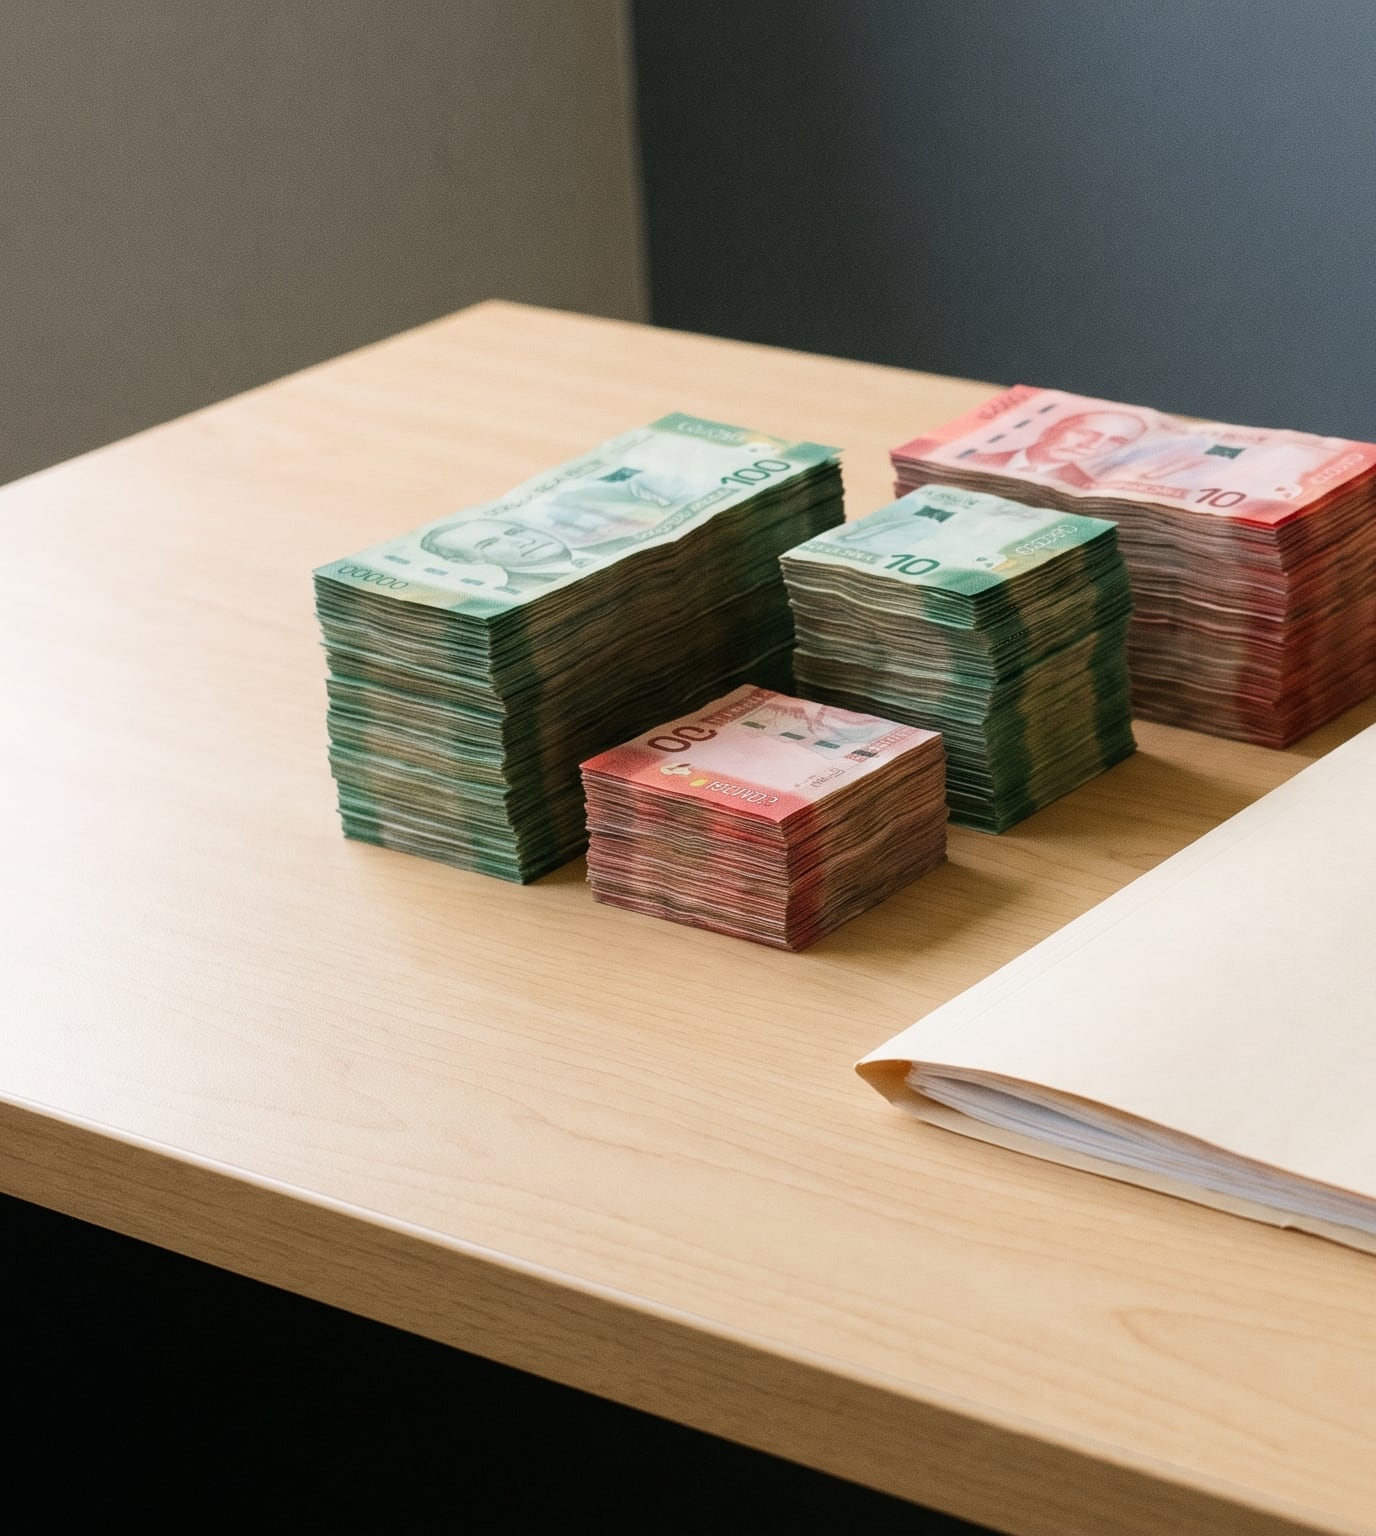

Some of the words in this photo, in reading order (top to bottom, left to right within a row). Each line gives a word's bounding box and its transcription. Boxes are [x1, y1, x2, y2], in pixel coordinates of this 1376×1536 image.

[720, 458, 791, 486] 100
[1195, 488, 1247, 509] 10
[884, 553, 940, 576] 10
